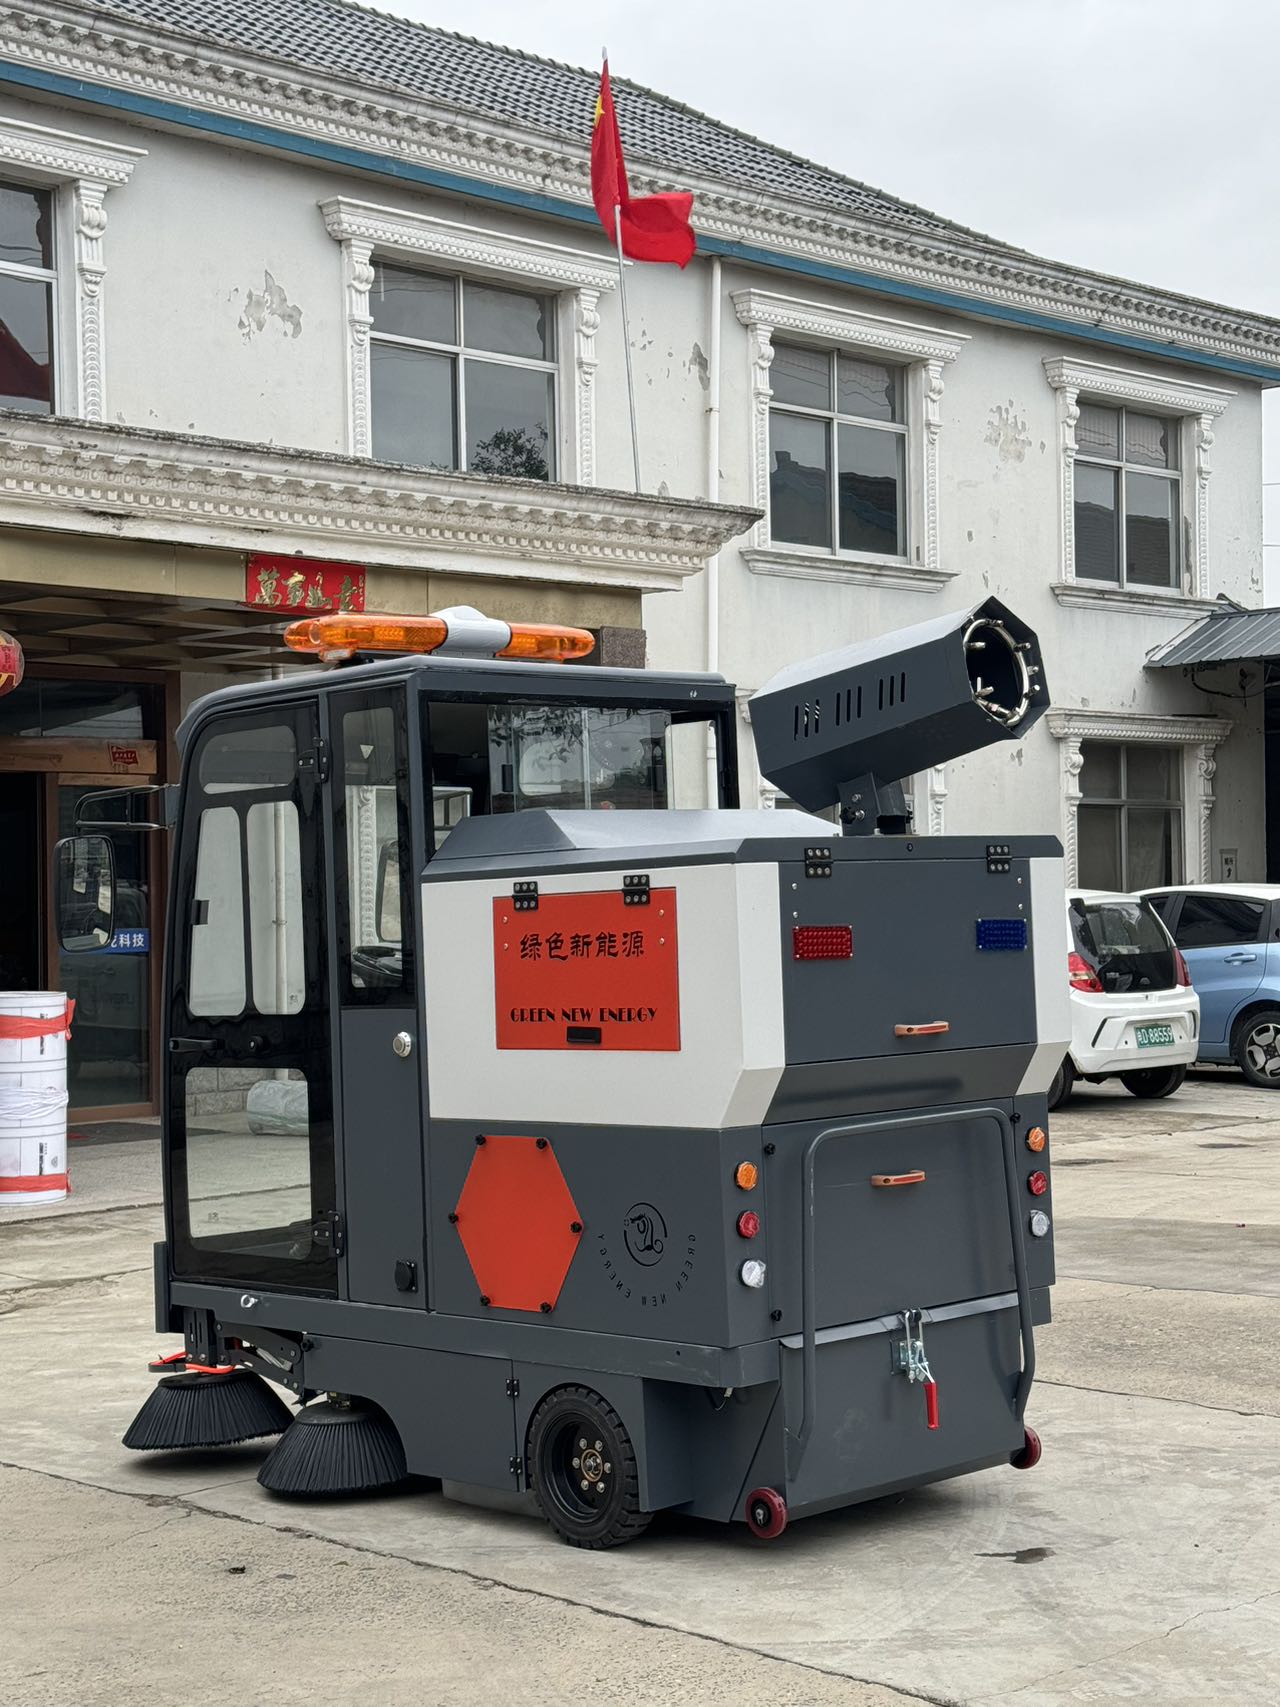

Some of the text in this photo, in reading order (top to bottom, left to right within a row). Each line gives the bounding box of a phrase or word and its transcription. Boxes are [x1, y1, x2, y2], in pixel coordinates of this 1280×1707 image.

[520, 931, 644, 961] 绿色新能源
[511, 1008, 657, 1022] GREEN NEW ENERGY
